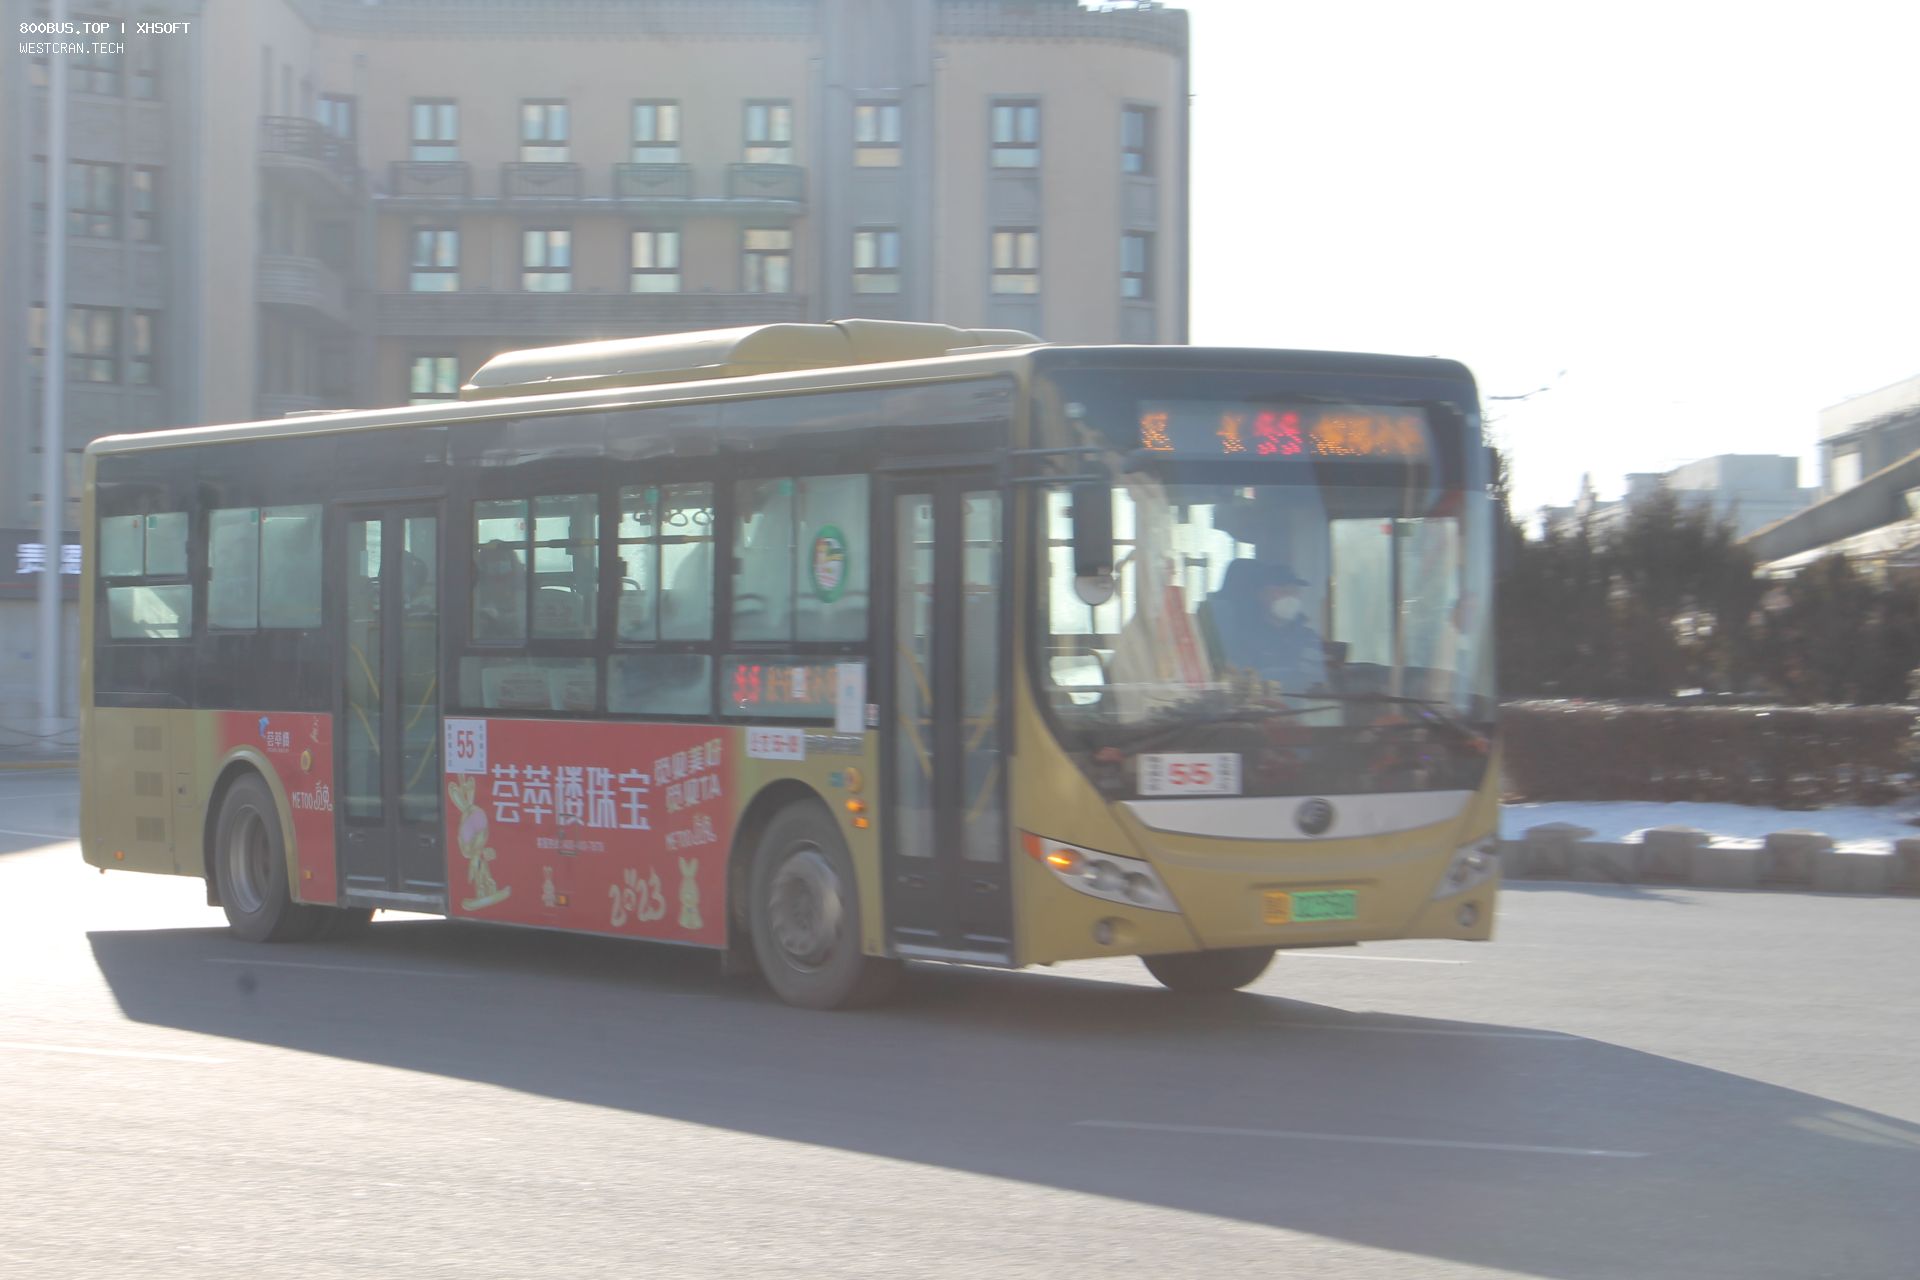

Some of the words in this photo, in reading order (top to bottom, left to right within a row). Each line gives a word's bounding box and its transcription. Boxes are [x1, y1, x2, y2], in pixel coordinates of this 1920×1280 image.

[1253, 411, 1302, 455] 55
[456, 729, 474, 759] 55
[1167, 762, 1213, 786] 55
[491, 763, 651, 831] 荟萃楼珠宝
